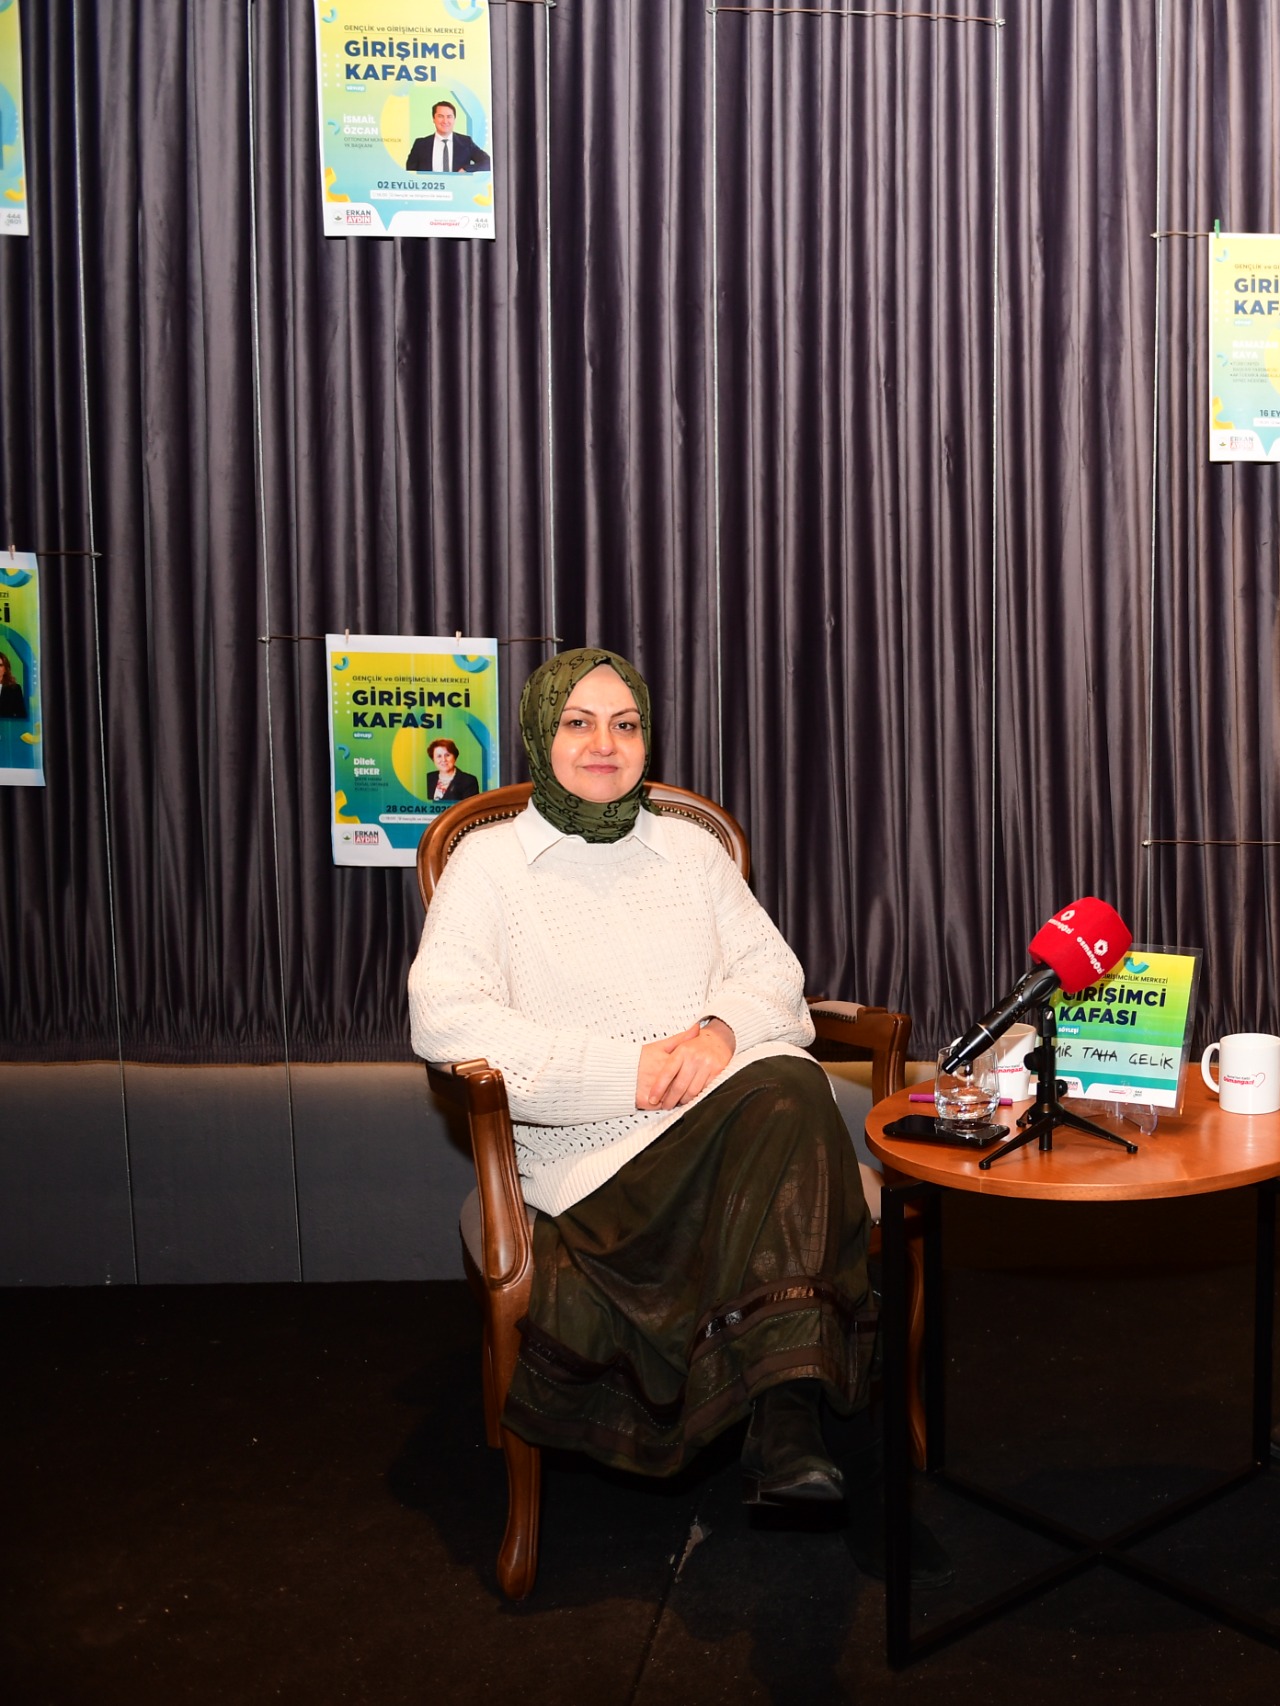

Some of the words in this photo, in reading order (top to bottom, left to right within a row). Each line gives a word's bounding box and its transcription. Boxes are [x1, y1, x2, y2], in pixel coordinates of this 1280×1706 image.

[344, 24, 374, 33] GENÇLİK
[387, 25, 431, 34] GİRİŞİMCİLİK
[344, 36, 465, 61] GİRİŞİMCİ
[345, 63, 436, 82] KAFASI
[344, 114, 375, 124] İSMAİL
[344, 125, 378, 135] ÖZCAN
[377, 181, 389, 189] 02
[392, 180, 419, 190] EYLÜL
[422, 182, 445, 190] 2025
[353, 675, 382, 683] GENÇLİK
[394, 675, 438, 684] GİRİŞİMCİLİK
[352, 686, 470, 709] GİRİŞİMCİ
[353, 712, 442, 729] KAFASI
[354, 758, 375, 766] Dilek
[354, 768, 380, 777] ŞEKER
[386, 805, 397, 813] 28
[1141, 976, 1168, 984] MERKEZİ
[1059, 1006, 1137, 1026] KAFASI
[1082, 1047, 1117, 1062] TAHA
